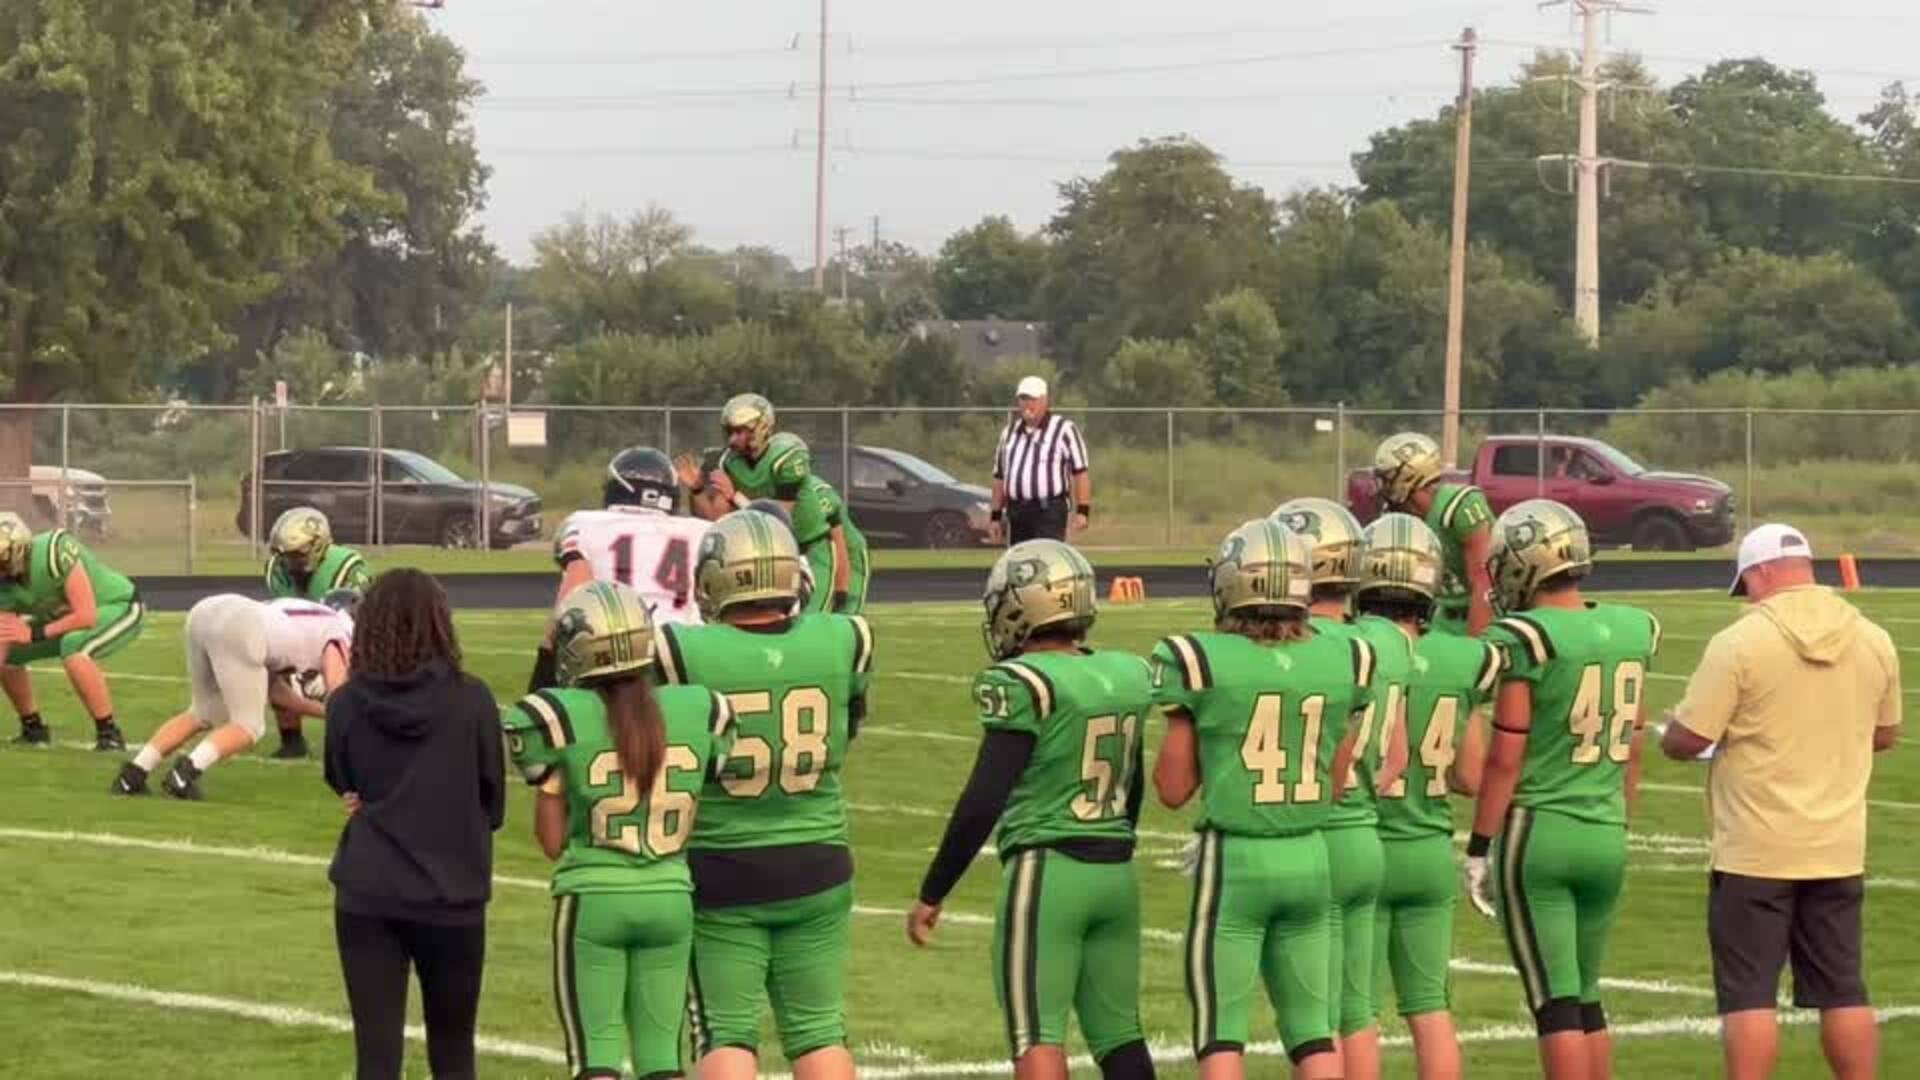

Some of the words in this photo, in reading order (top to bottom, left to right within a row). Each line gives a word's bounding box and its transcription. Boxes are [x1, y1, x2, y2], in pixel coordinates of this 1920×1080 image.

[609, 533, 689, 608] 14
[735, 570, 753, 587] 58
[1059, 592, 1073, 609] 51
[1119, 580, 1141, 601] 10
[720, 685, 829, 797] 58
[979, 683, 1009, 717] 51
[1568, 659, 1644, 765] 48
[1070, 713, 1137, 821] 51
[1241, 693, 1326, 804] 41
[588, 743, 701, 858] 26
